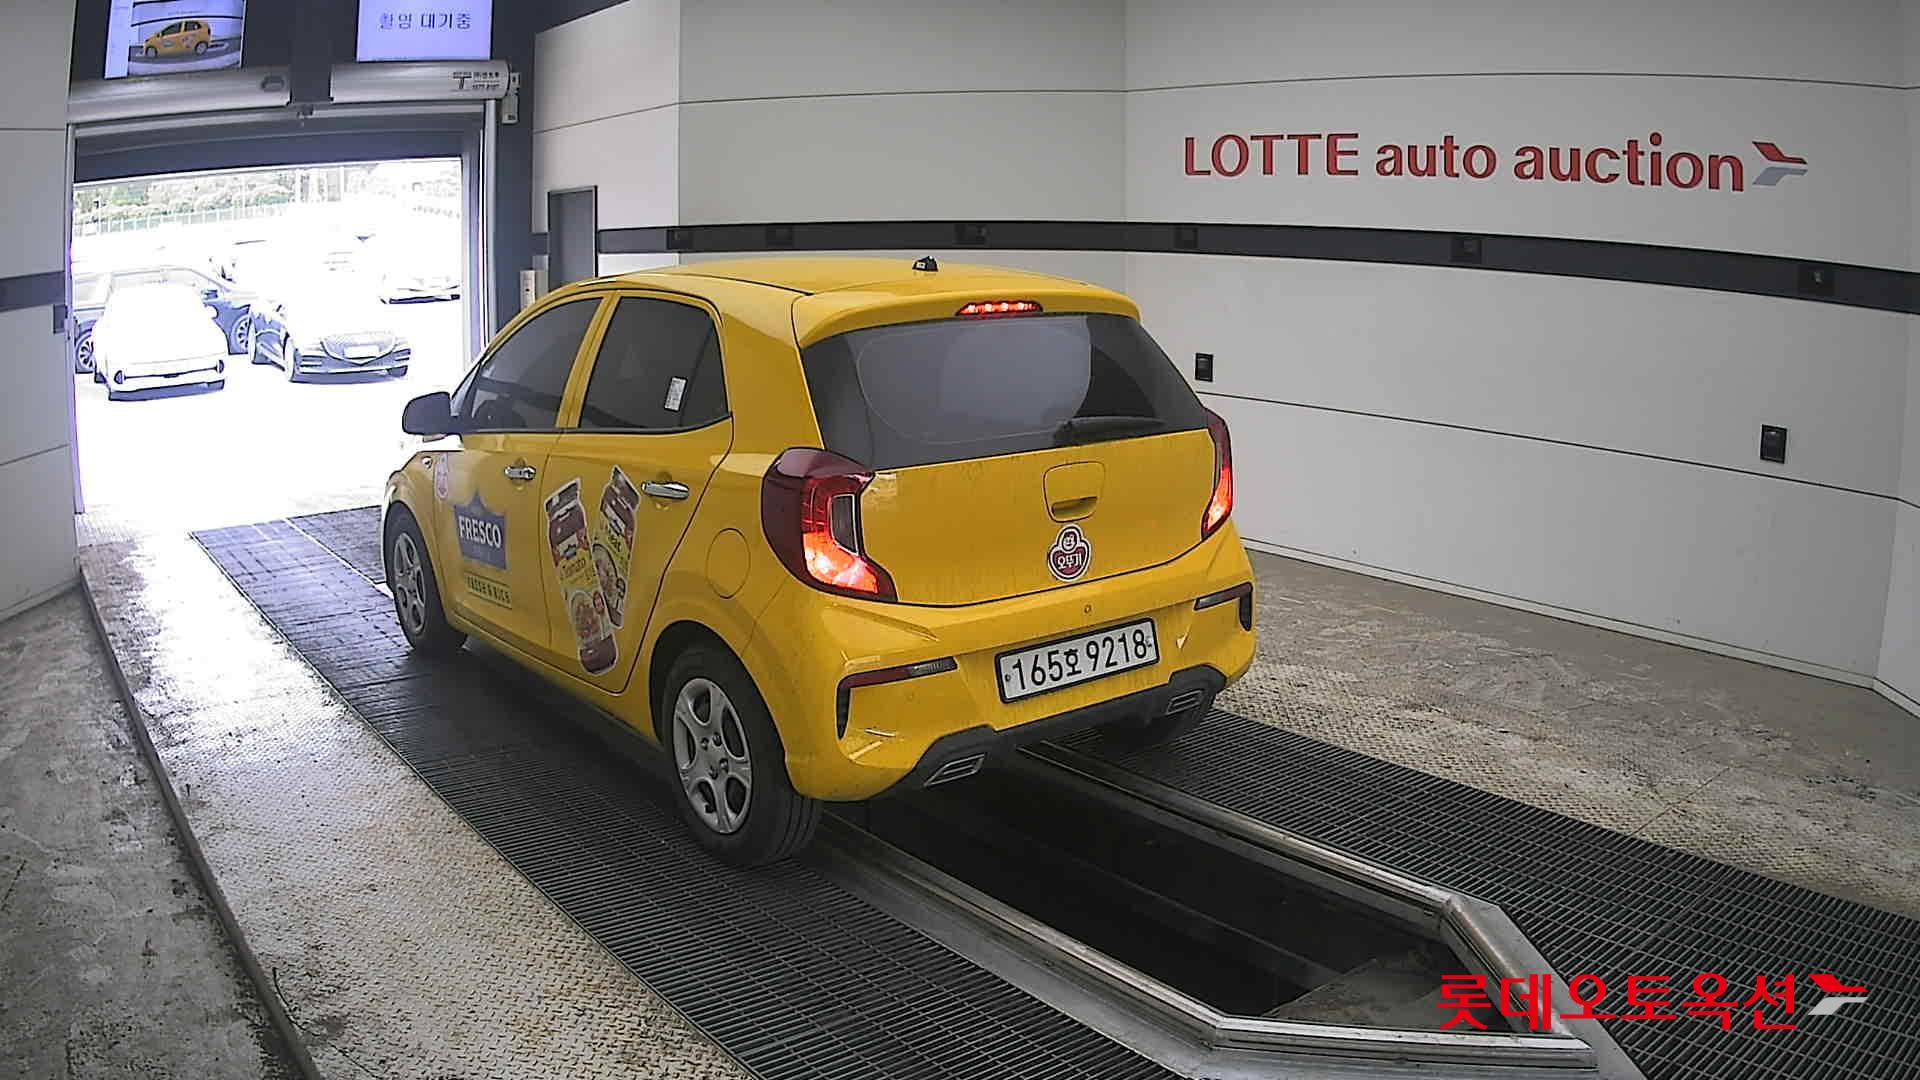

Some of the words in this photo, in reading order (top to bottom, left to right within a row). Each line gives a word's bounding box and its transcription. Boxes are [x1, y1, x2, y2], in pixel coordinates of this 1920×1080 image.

[420, 12, 472, 30] 대기중
[1183, 132, 1360, 177] LOTTE
[1375, 135, 1498, 180] auto
[1513, 131, 1745, 192] auction
[458, 515, 502, 549] FRESCO
[1057, 551, 1082, 570] 오뚜기
[1012, 648, 1082, 691] 165호
[1085, 629, 1147, 672] 9218
